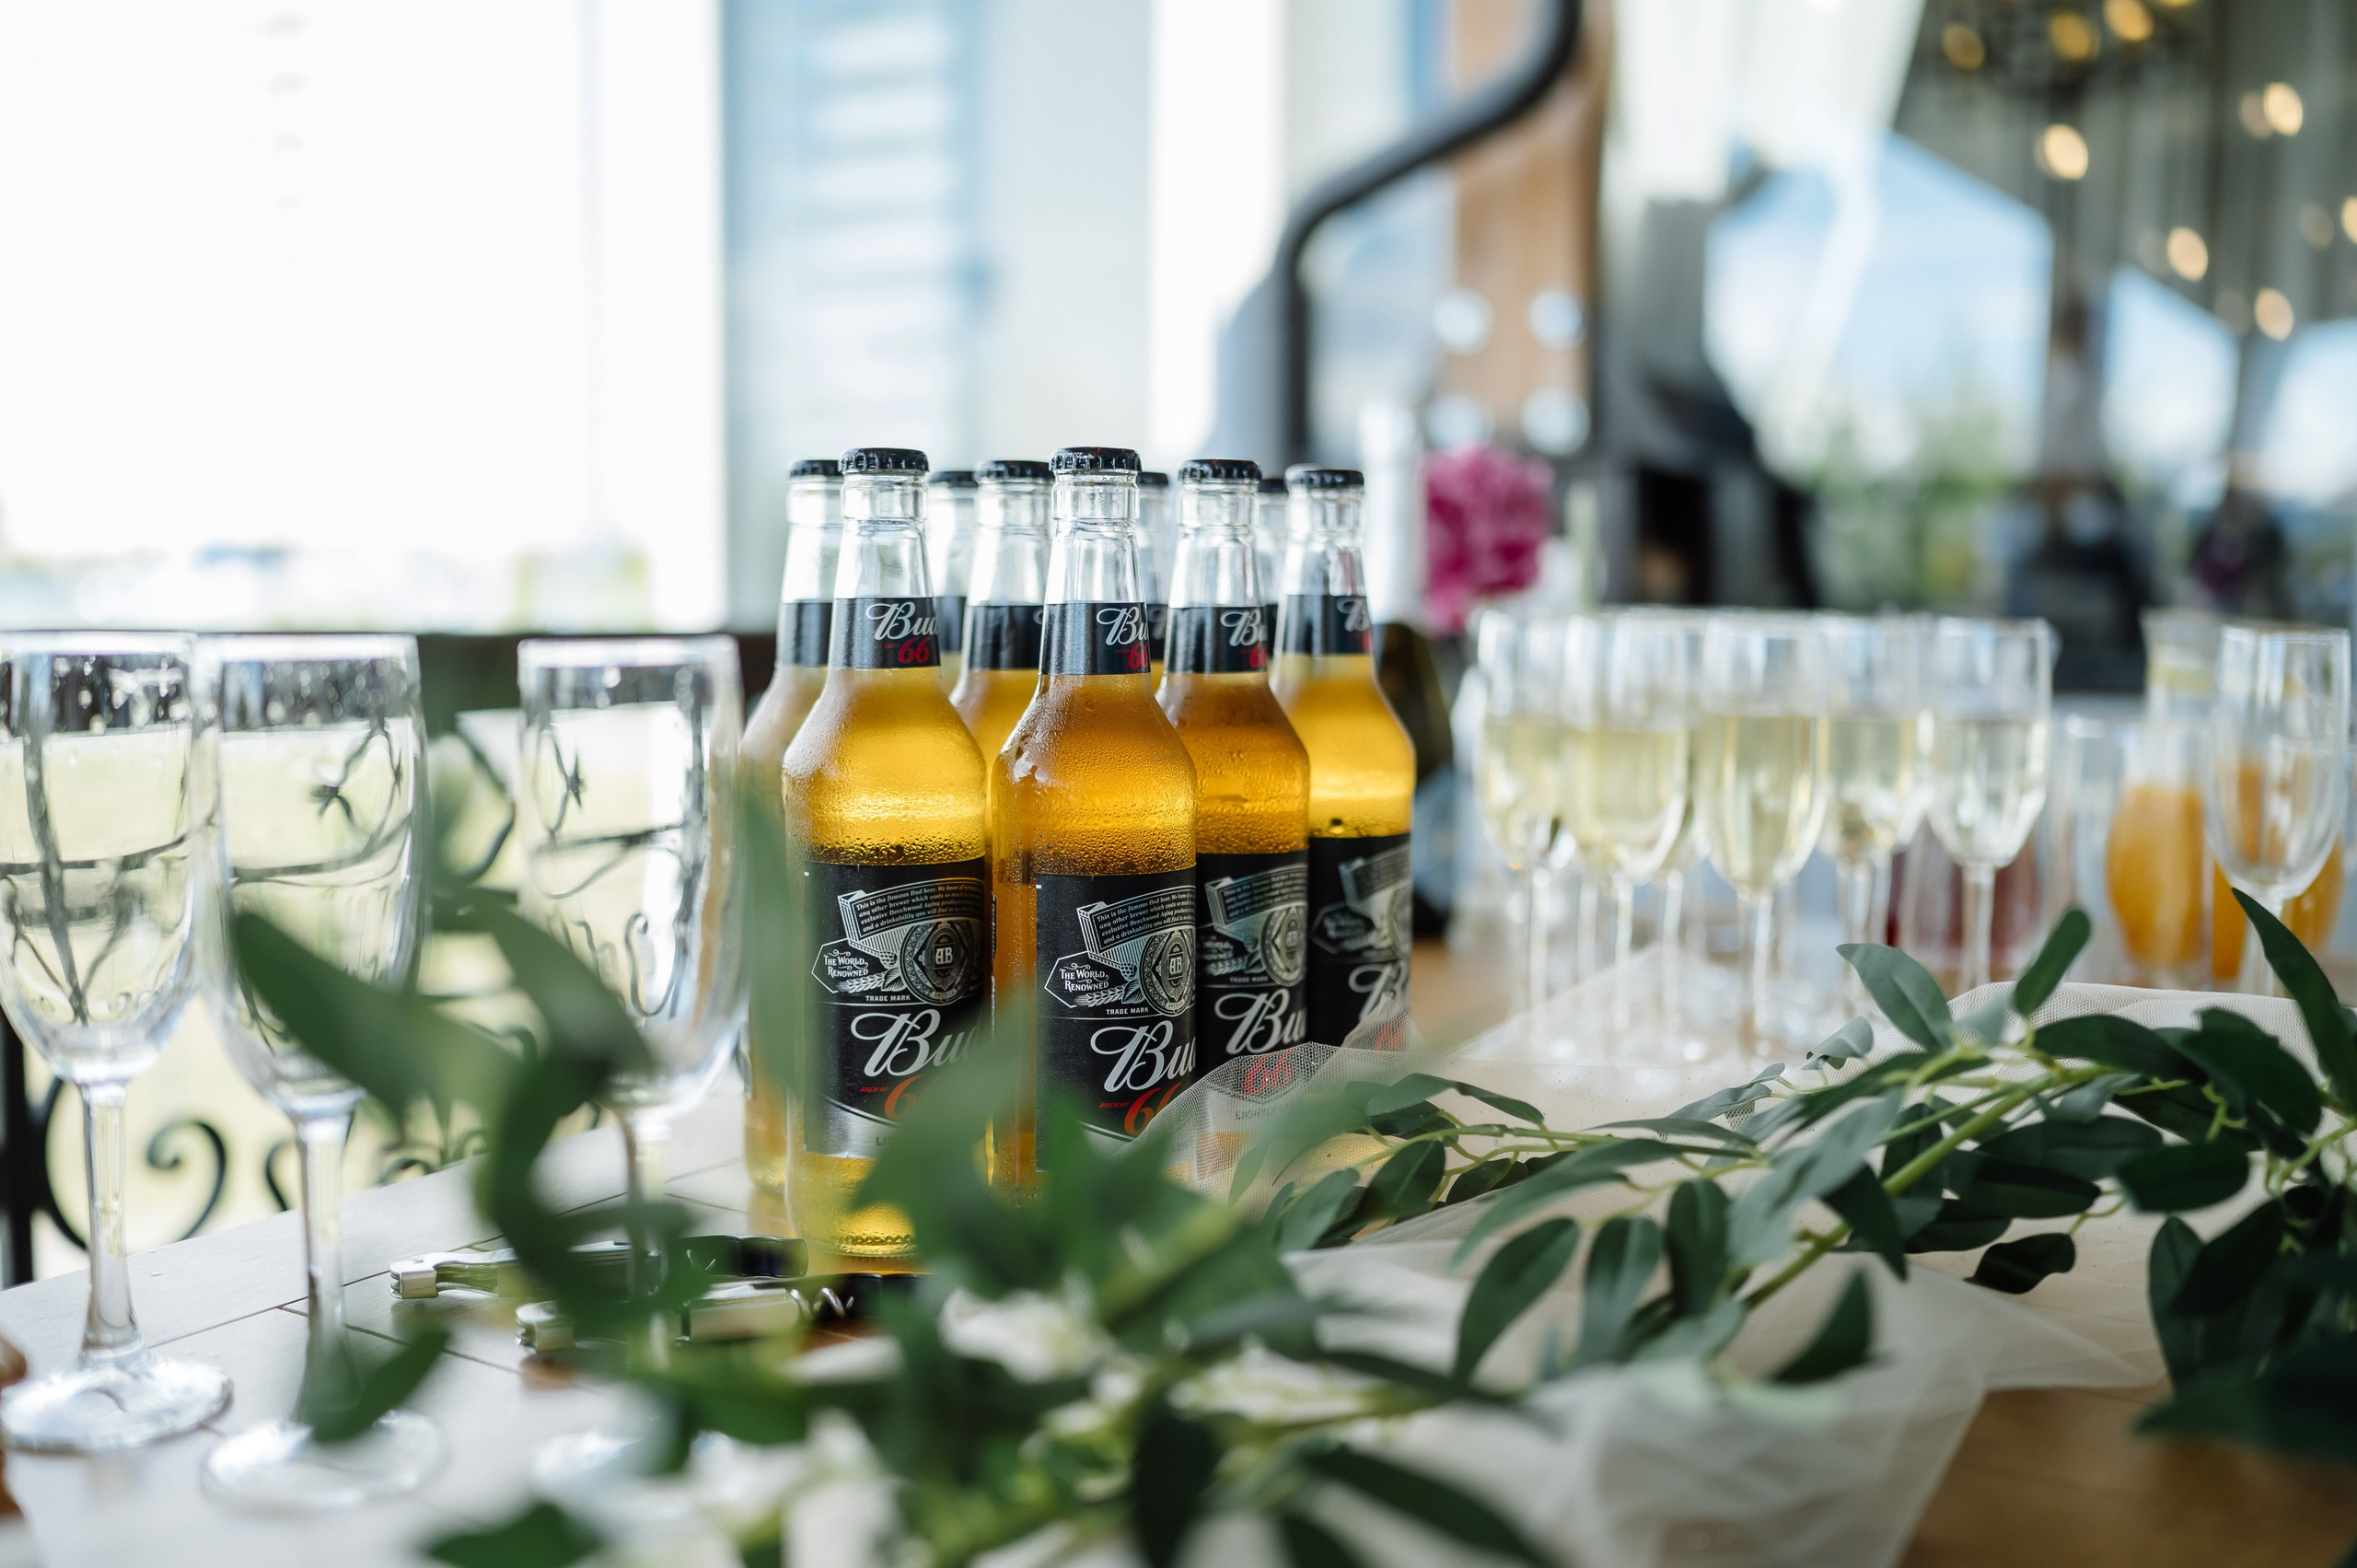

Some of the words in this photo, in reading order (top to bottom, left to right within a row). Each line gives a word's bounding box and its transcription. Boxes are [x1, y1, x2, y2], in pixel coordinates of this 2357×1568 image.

[1096, 606, 1148, 645] Bu
[898, 636, 931, 664] 66
[856, 902, 869, 911] This
[887, 892, 910, 902] famous
[871, 905, 888, 913] other
[888, 899, 910, 909] brewer
[911, 895, 928, 903] which
[861, 912, 888, 925] exclusive
[889, 904, 923, 916] Beechwood
[863, 923, 874, 932] and
[880, 913, 915, 926] drinkability
[1097, 913, 1110, 923] This
[1128, 902, 1148, 912] famous
[1099, 922, 1111, 930] any
[1112, 915, 1129, 925] other
[1129, 909, 1149, 919] brewer
[1101, 923, 1129, 936] exclusive
[1130, 912, 1160, 926] Beechwood
[1103, 936, 1115, 945] and
[1120, 923, 1153, 937] drinkability
[823, 955, 837, 966] THE
[828, 966, 869, 978] RENOWNED
[1059, 969, 1075, 980] THE
[1064, 980, 1109, 993] RENOWNED
[1214, 988, 1306, 1055] Bu
[851, 1008, 978, 1077] Bu
